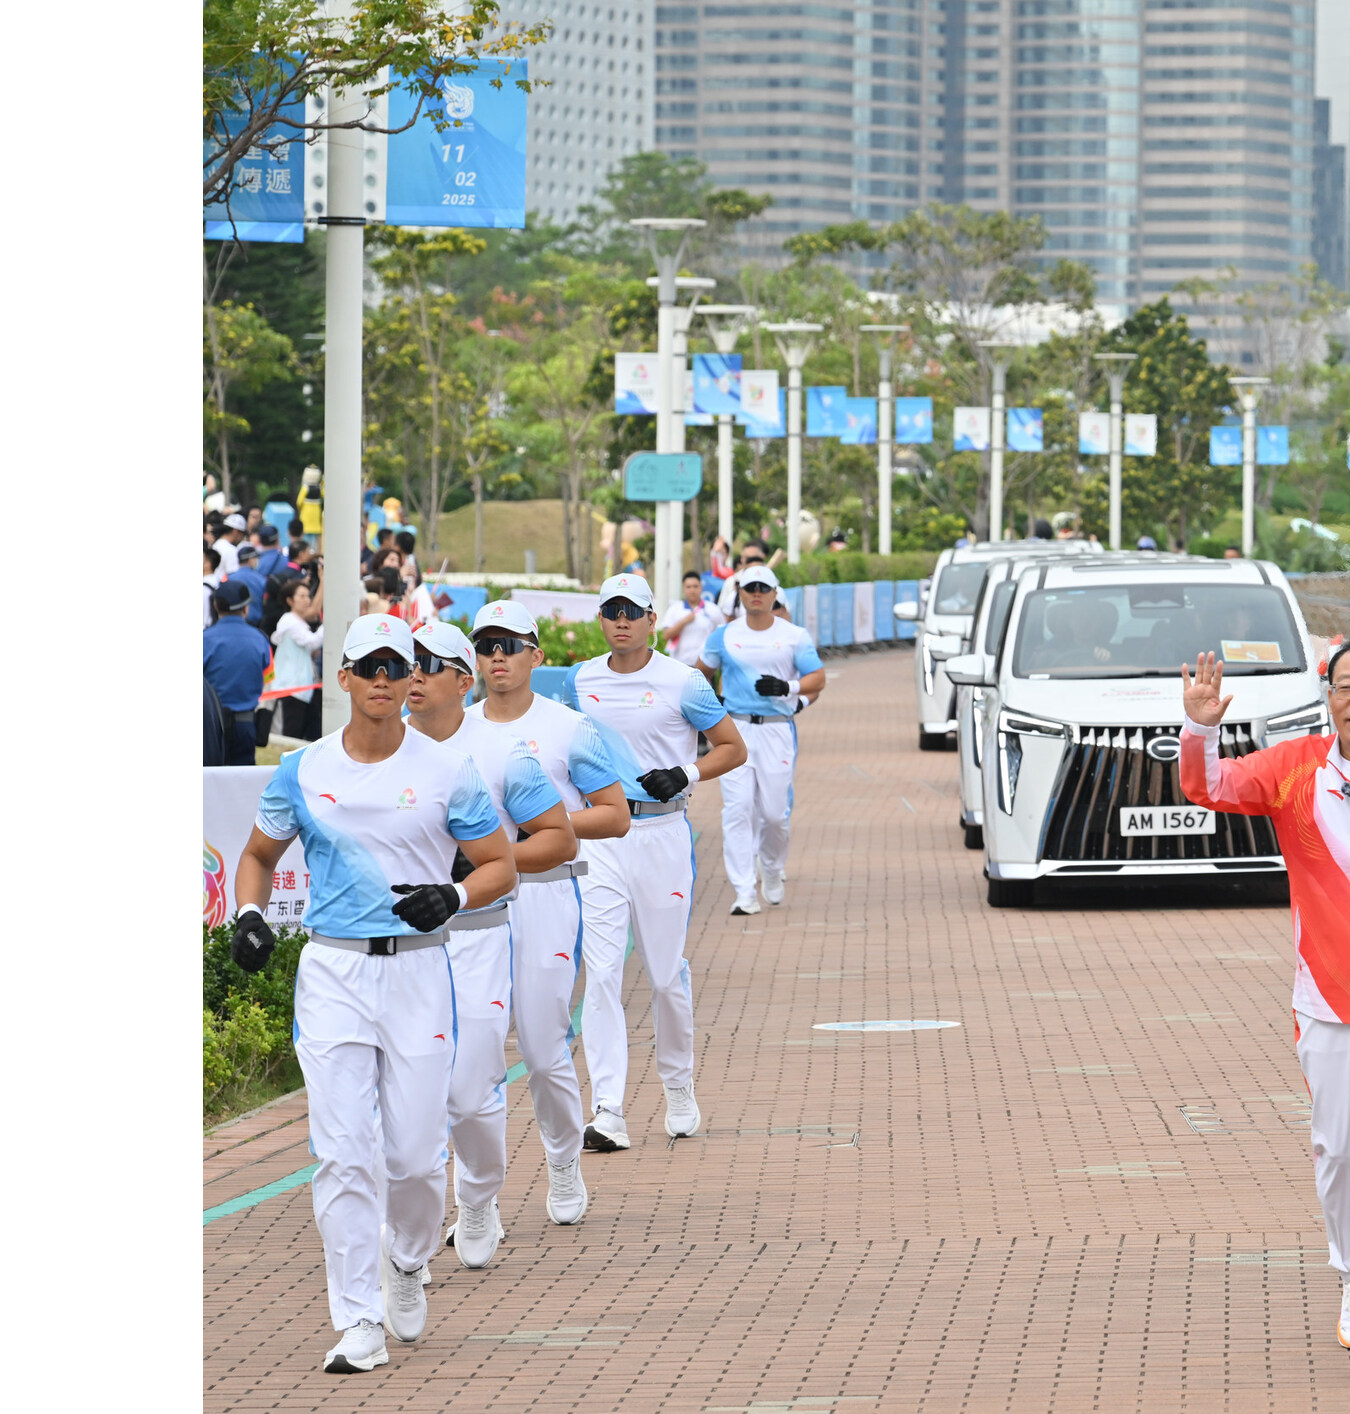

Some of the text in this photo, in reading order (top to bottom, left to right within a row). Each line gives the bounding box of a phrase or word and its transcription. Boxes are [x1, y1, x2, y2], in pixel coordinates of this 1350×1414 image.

[441, 144, 465, 163] 11
[455, 171, 477, 187] 02
[441, 193, 476, 206] 2025
[1127, 811, 1209, 830] AM 1567
